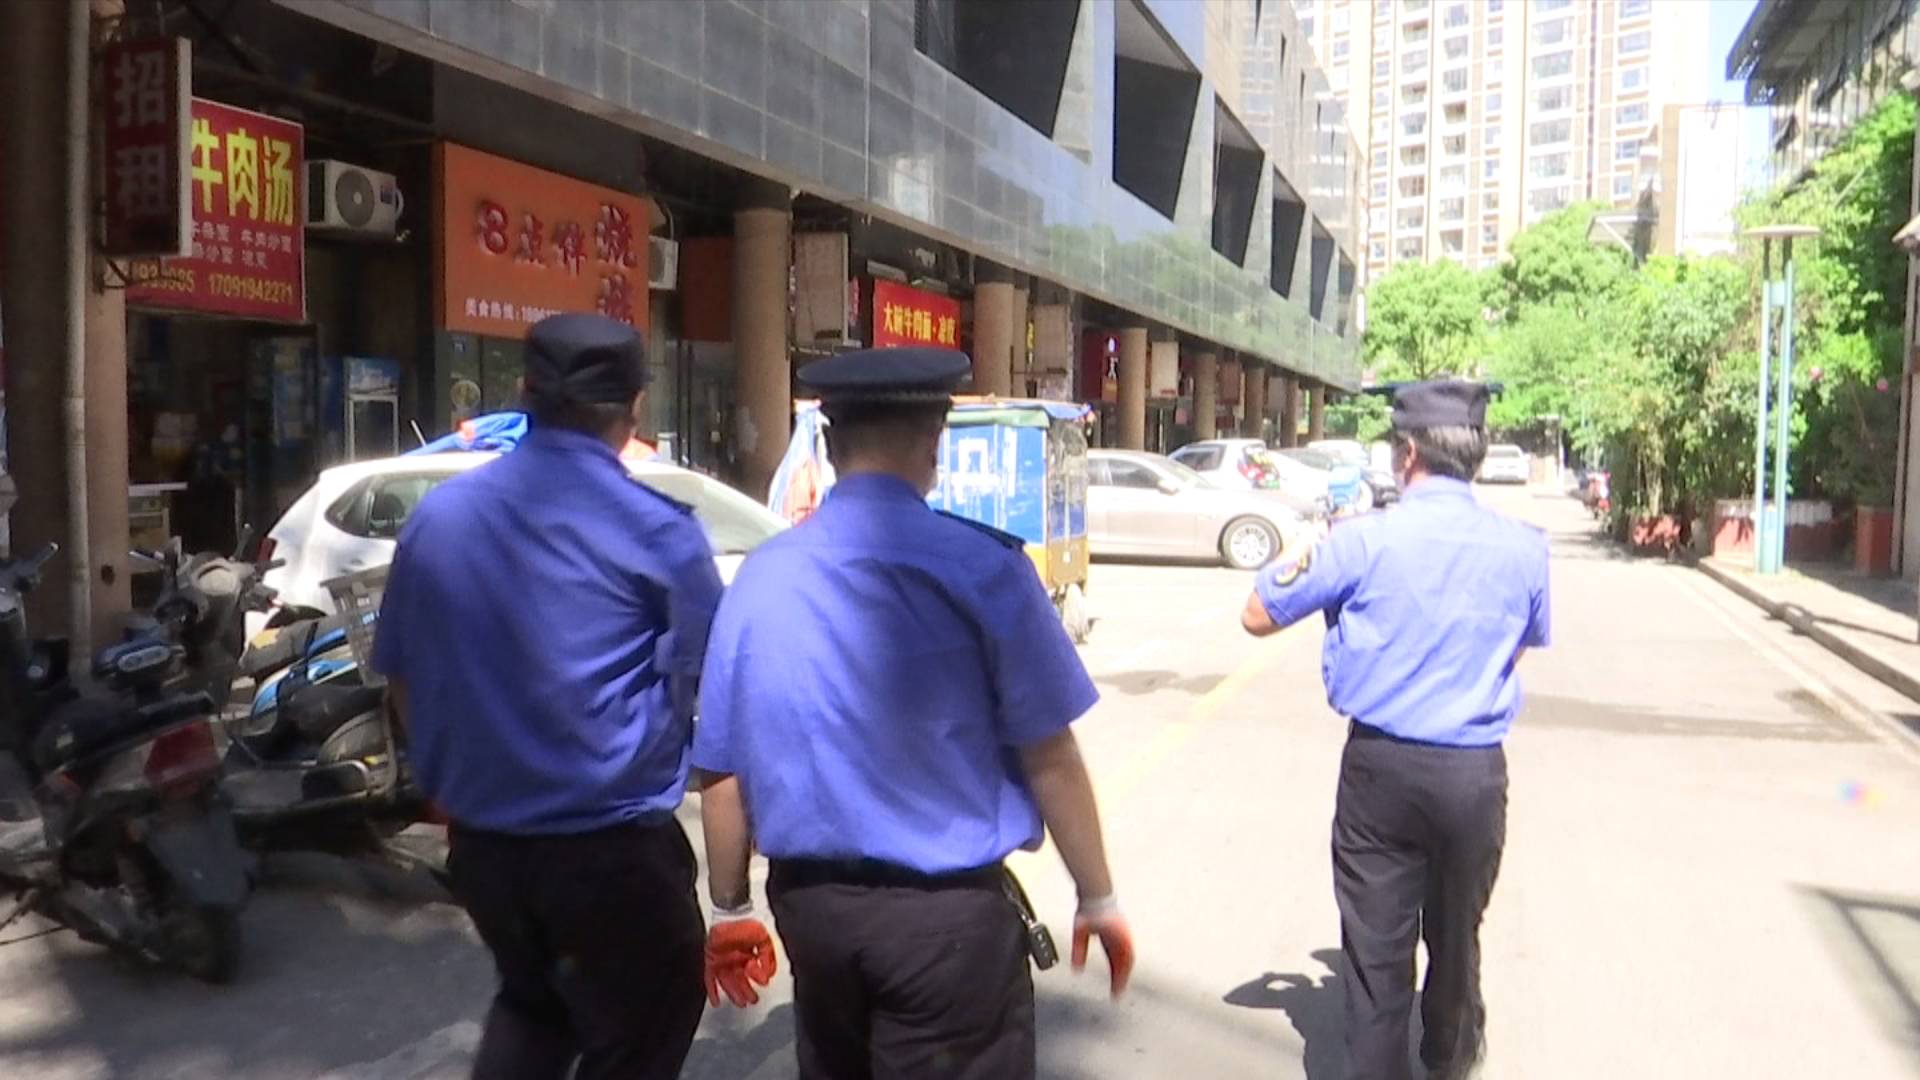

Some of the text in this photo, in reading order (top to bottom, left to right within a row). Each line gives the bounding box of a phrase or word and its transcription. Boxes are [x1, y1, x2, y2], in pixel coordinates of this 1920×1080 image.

[113, 51, 168, 218] 招租
[192, 118, 294, 227] 牛肉汤
